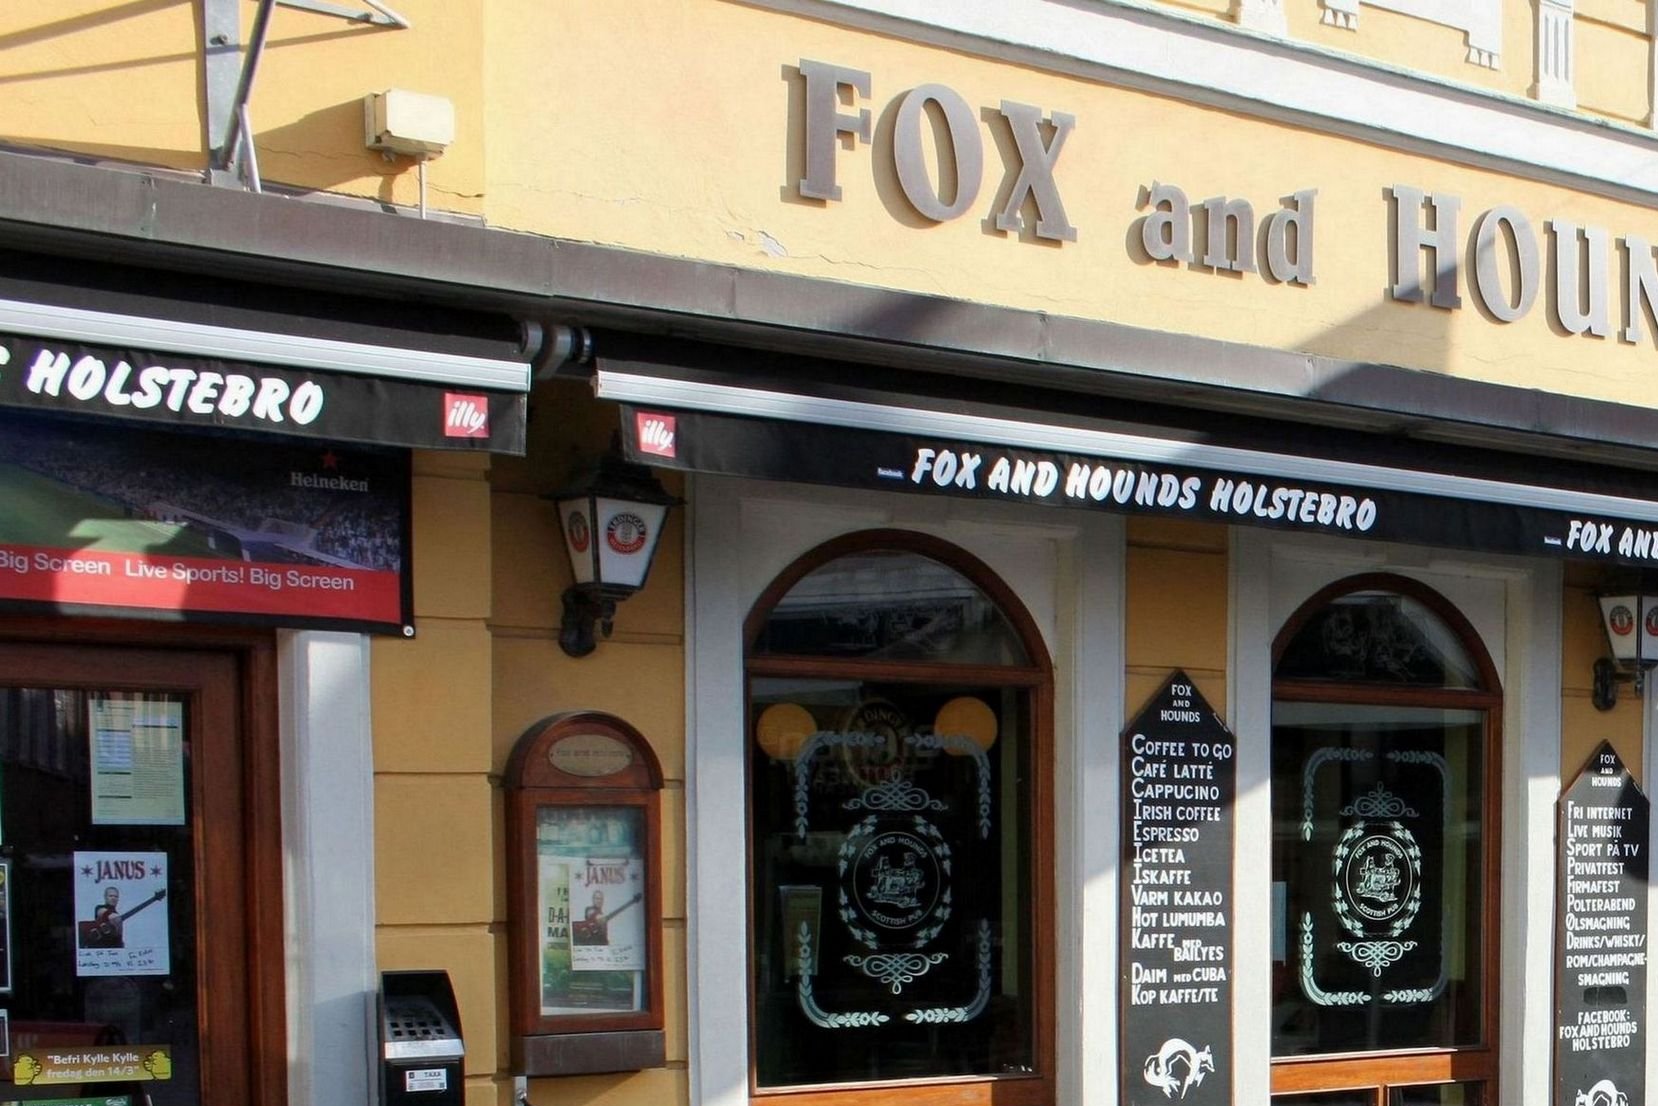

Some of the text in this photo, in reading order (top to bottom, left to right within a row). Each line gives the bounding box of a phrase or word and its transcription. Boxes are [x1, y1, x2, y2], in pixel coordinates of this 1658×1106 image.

[788, 58, 1078, 242] FOX
[1136, 180, 1319, 287] and
[26, 348, 324, 425] HOLSTEBRO
[447, 401, 486, 434] illy
[641, 420, 674, 449] illy
[290, 471, 369, 492] Heineken
[911, 448, 1377, 532] FOX AND HOUNDS HOLSTEBRO
[1567, 520, 1612, 555] FOX
[34, 552, 111, 575] Screen
[125, 558, 167, 578] Live
[172, 562, 245, 585] Sports!
[250, 567, 282, 589] Big
[286, 572, 355, 591] Screen
[1171, 683, 1192, 697] FOX
[1172, 699, 1191, 708] AND
[1160, 709, 1201, 723] HOUNDS
[1131, 733, 1232, 760] COFFEE TO GO
[1600, 753, 1616, 765] FOX
[1600, 767, 1614, 775] AND
[1131, 778, 1220, 801] CAPPUCINO
[1591, 776, 1622, 788] HOUNDS
[1133, 799, 1221, 822] IRISH COFFEE
[1567, 800, 1633, 821] FRI INTERNET
[1133, 821, 1199, 842] ESPRESSO
[1567, 820, 1622, 839] LIVE MUSIK
[879, 836, 897, 847] AND
[1566, 837, 1640, 858] SPORT PÅ TV
[1133, 842, 1186, 864] ICETEA
[94, 859, 146, 884] JANUS
[584, 866, 626, 887] JANUS
[1133, 863, 1192, 885] ISKAFFE
[1567, 856, 1625, 876] PRIVATFEST
[1131, 884, 1223, 906] VARM KAKAO
[1567, 875, 1621, 894] FIRMAFEST
[1359, 903, 1386, 917] SCOTTISH
[1566, 893, 1636, 913] POLTERABEND
[871, 909, 907, 926] SCOTTISH
[1131, 906, 1226, 928] HOT LUMUMBA
[1565, 912, 1631, 931] ØLSMAGNING
[1131, 927, 1175, 950] KAFFE
[1173, 946, 1224, 962] BAILYES
[1131, 962, 1227, 984] DAIM MED CUBA
[1577, 971, 1630, 987] SMAGNING
[1131, 983, 1219, 1005] KOP KAFFE/TE
[1577, 1009, 1631, 1025] FACEBOOK:
[1559, 1021, 1638, 1040] FOX AND HOUNDS
[1572, 1035, 1631, 1052] HOLSTEBRO
[83, 1052, 110, 1066] Kylle
[112, 1051, 140, 1064] Kylle
[47, 1068, 82, 1079] fredag
[85, 1067, 105, 1078] den
